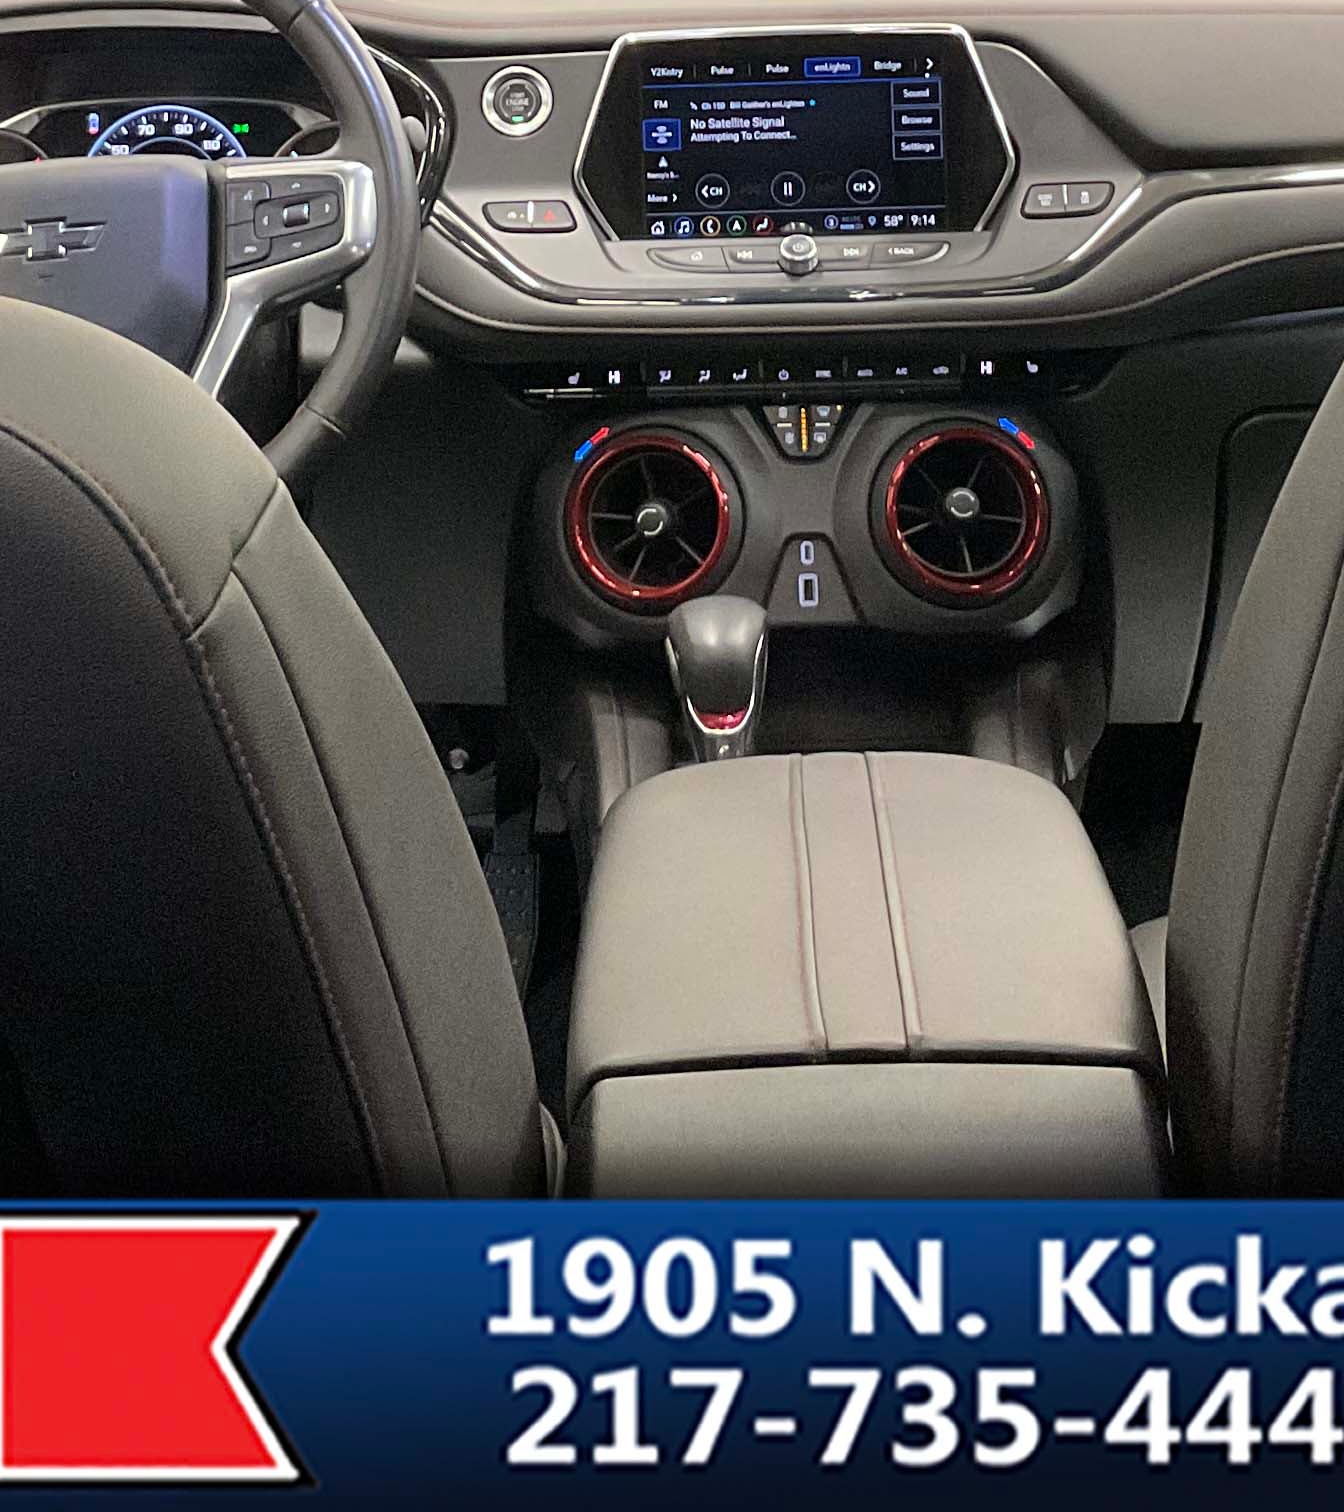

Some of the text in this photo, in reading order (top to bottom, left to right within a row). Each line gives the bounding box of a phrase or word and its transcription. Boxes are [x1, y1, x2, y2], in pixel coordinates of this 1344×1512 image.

[710, 65, 735, 76] Pulse
[765, 63, 790, 74] Pulse
[873, 60, 902, 72] Bridge
[902, 88, 930, 98] Sound
[653, 99, 669, 110] FM
[690, 115, 785, 130] No Satellite Signal
[901, 114, 933, 126] Browse
[690, 131, 740, 143] Attempting
[741, 131, 753, 141] To
[900, 141, 935, 152] Settings
[709, 186, 723, 196] CH
[852, 182, 867, 192] CH
[647, 193, 668, 203] More
[910, 213, 936, 226] 9:14
